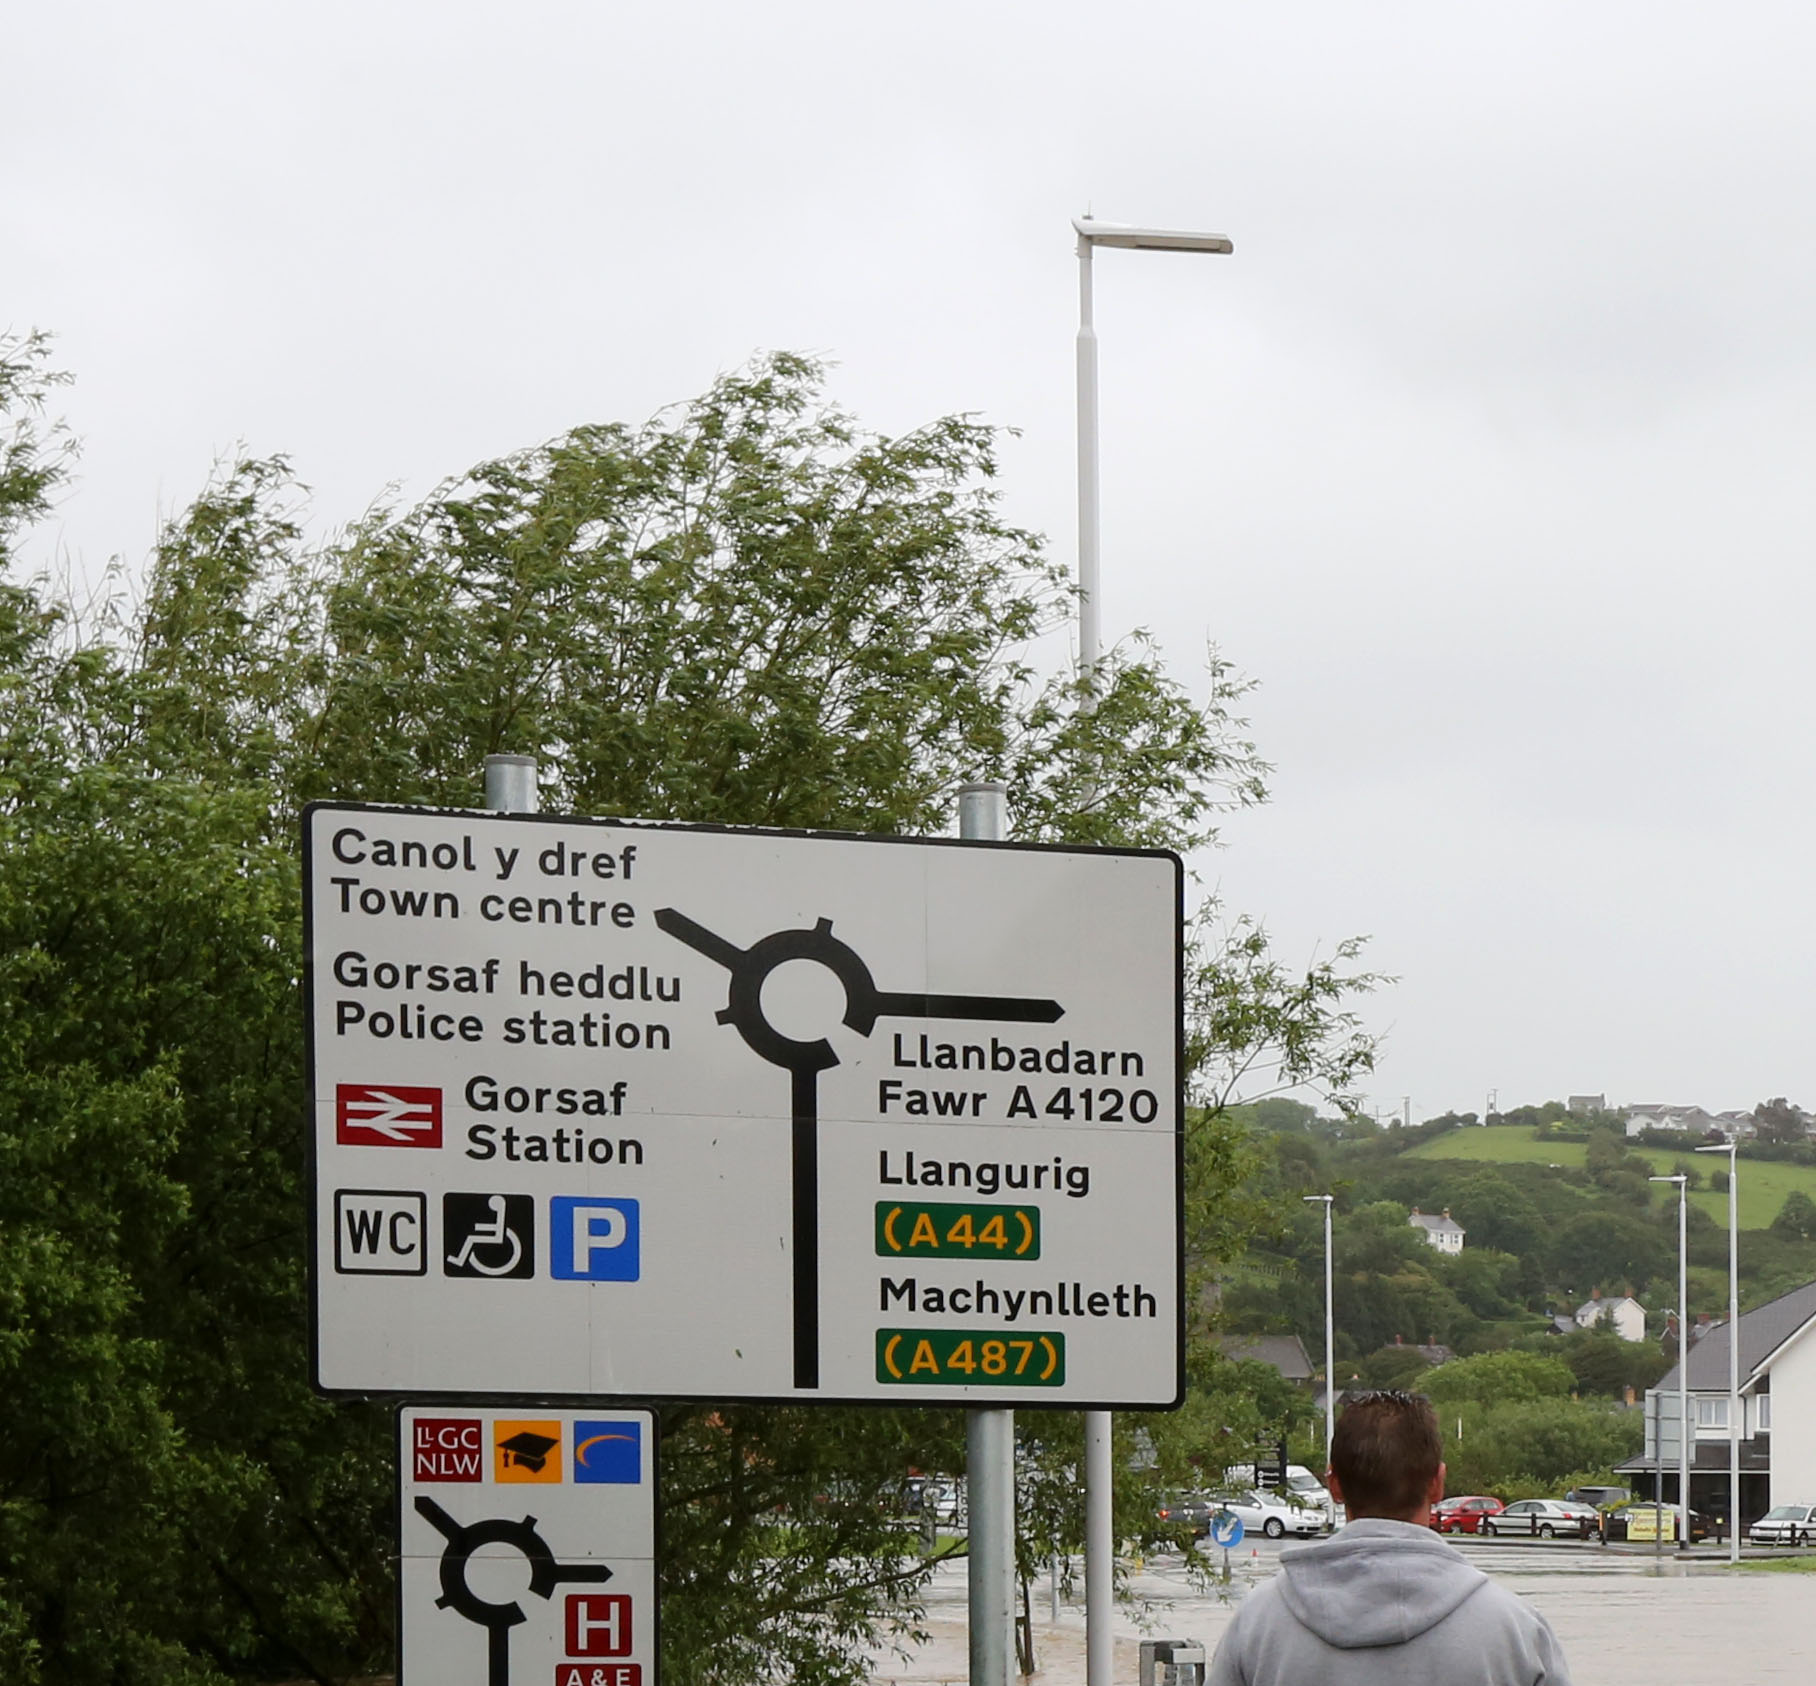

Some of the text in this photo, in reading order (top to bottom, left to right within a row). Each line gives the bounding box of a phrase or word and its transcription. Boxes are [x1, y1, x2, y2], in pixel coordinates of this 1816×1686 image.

[331, 827, 637, 881] Canol y dref
[330, 876, 636, 929] Town centre
[333, 950, 682, 1003] Gorsaf heddlu
[336, 1000, 671, 1050] Police station
[893, 1032, 1144, 1077] Llanbadarn
[464, 1075, 628, 1116] Gorsaf
[879, 1079, 1160, 1124] Fawr A4120
[464, 1123, 643, 1165] Station
[879, 1150, 1090, 1198] Llangurig
[345, 1208, 417, 1256] WC
[573, 1206, 627, 1273] P
[885, 1208, 1033, 1254] (A44)
[880, 1277, 1157, 1322] Machynlleth
[885, 1335, 1057, 1379] (A487)
[417, 1454, 480, 1475] NLW
[577, 1601, 620, 1651] H
